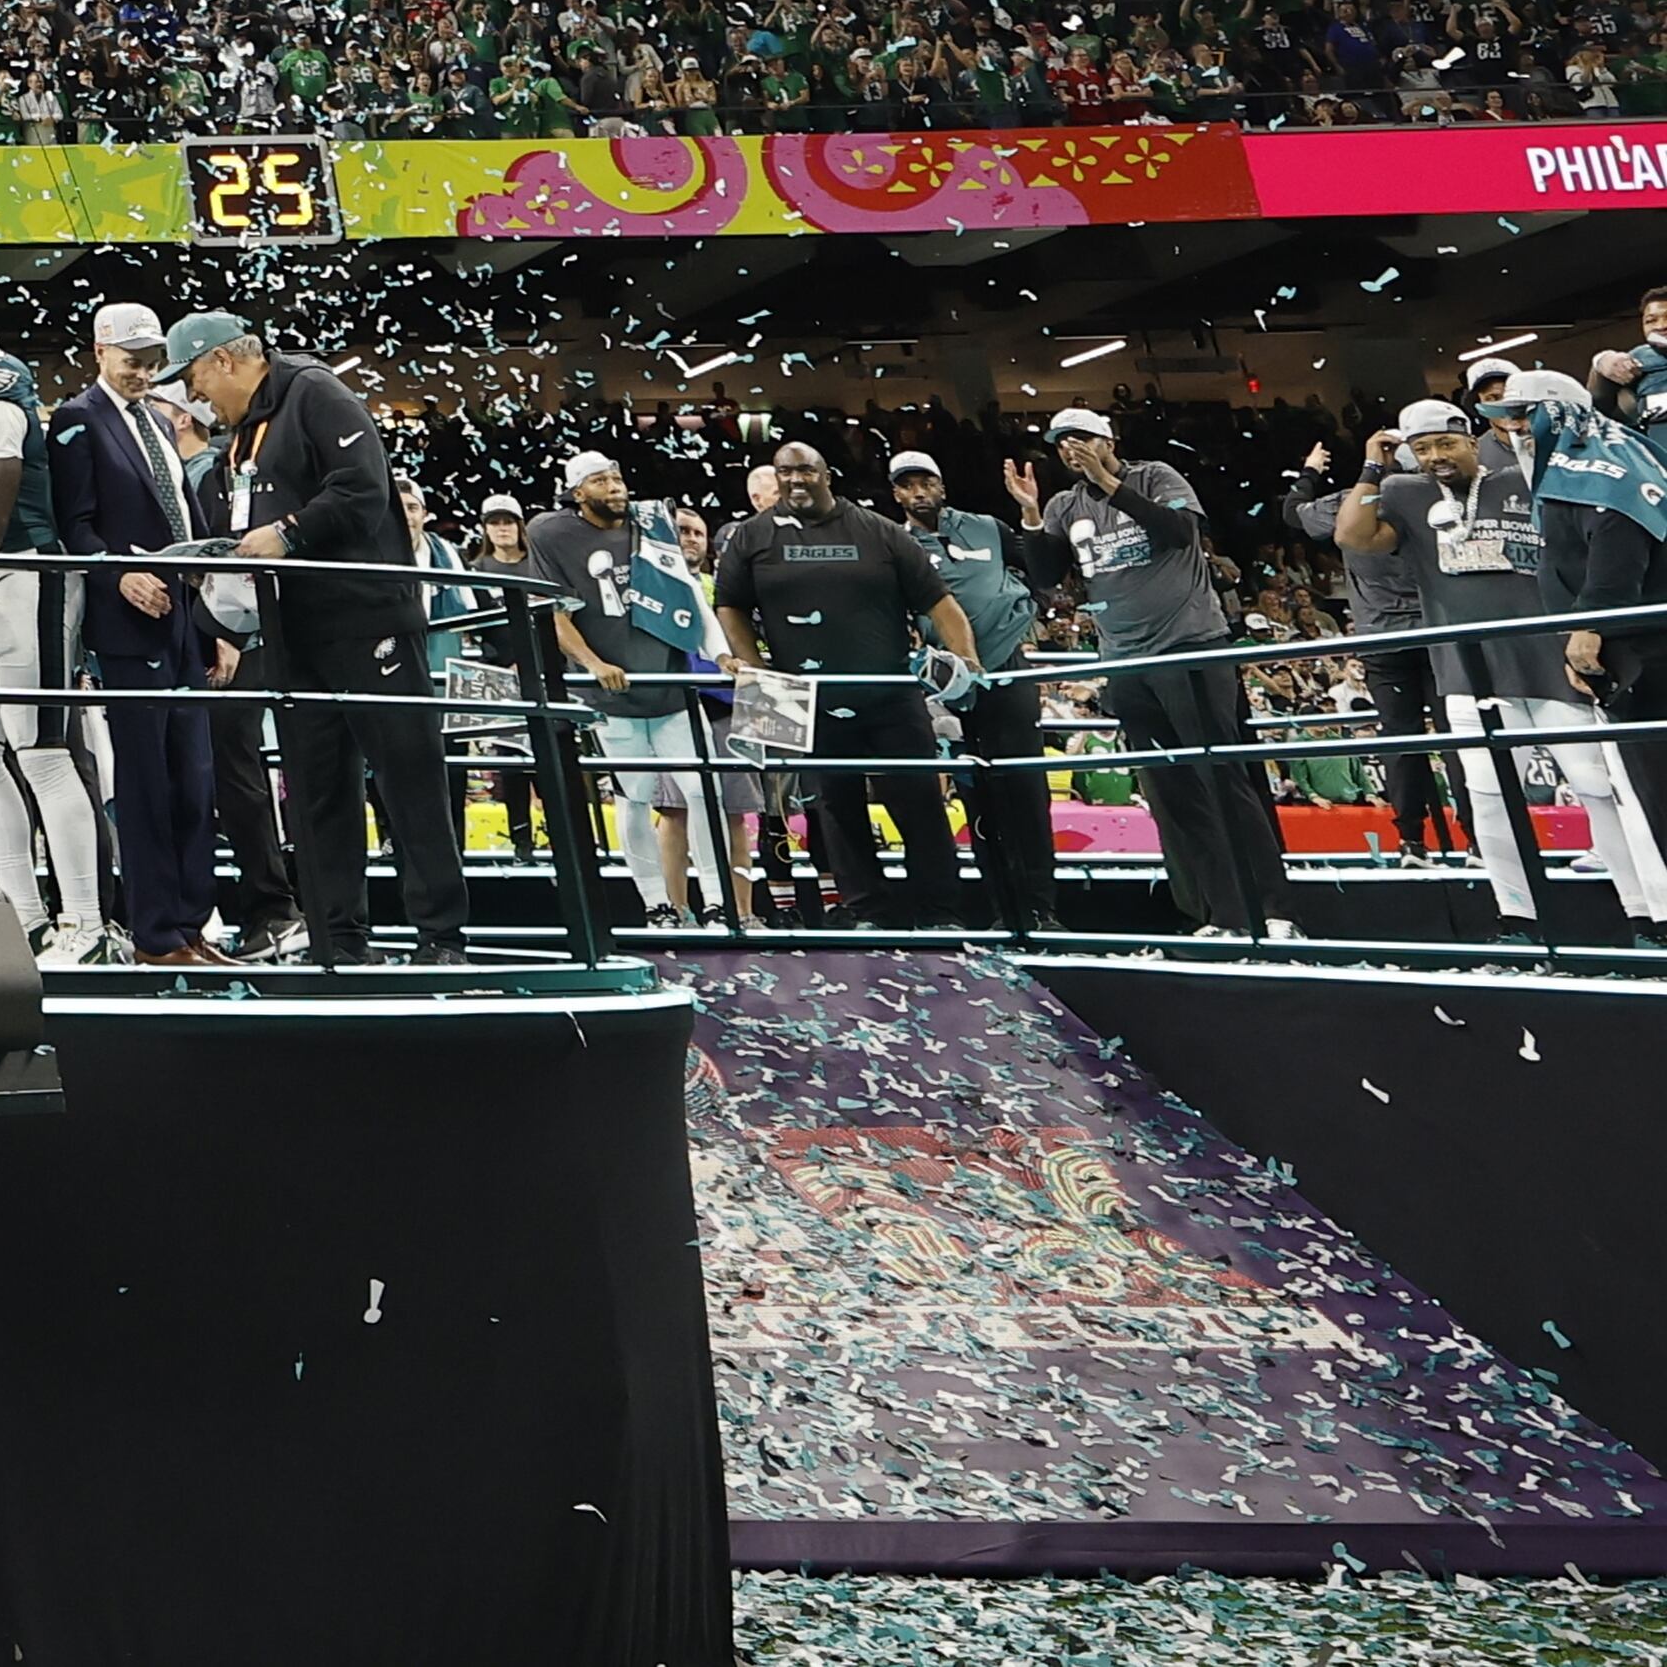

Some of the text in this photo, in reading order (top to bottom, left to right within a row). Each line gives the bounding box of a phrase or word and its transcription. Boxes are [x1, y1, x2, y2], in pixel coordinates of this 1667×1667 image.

[208, 154, 313, 227] 25
[1472, 529, 1541, 546] HAMPIONS
[787, 545, 855, 559] EAGLES
[1524, 760, 1558, 787] 26
